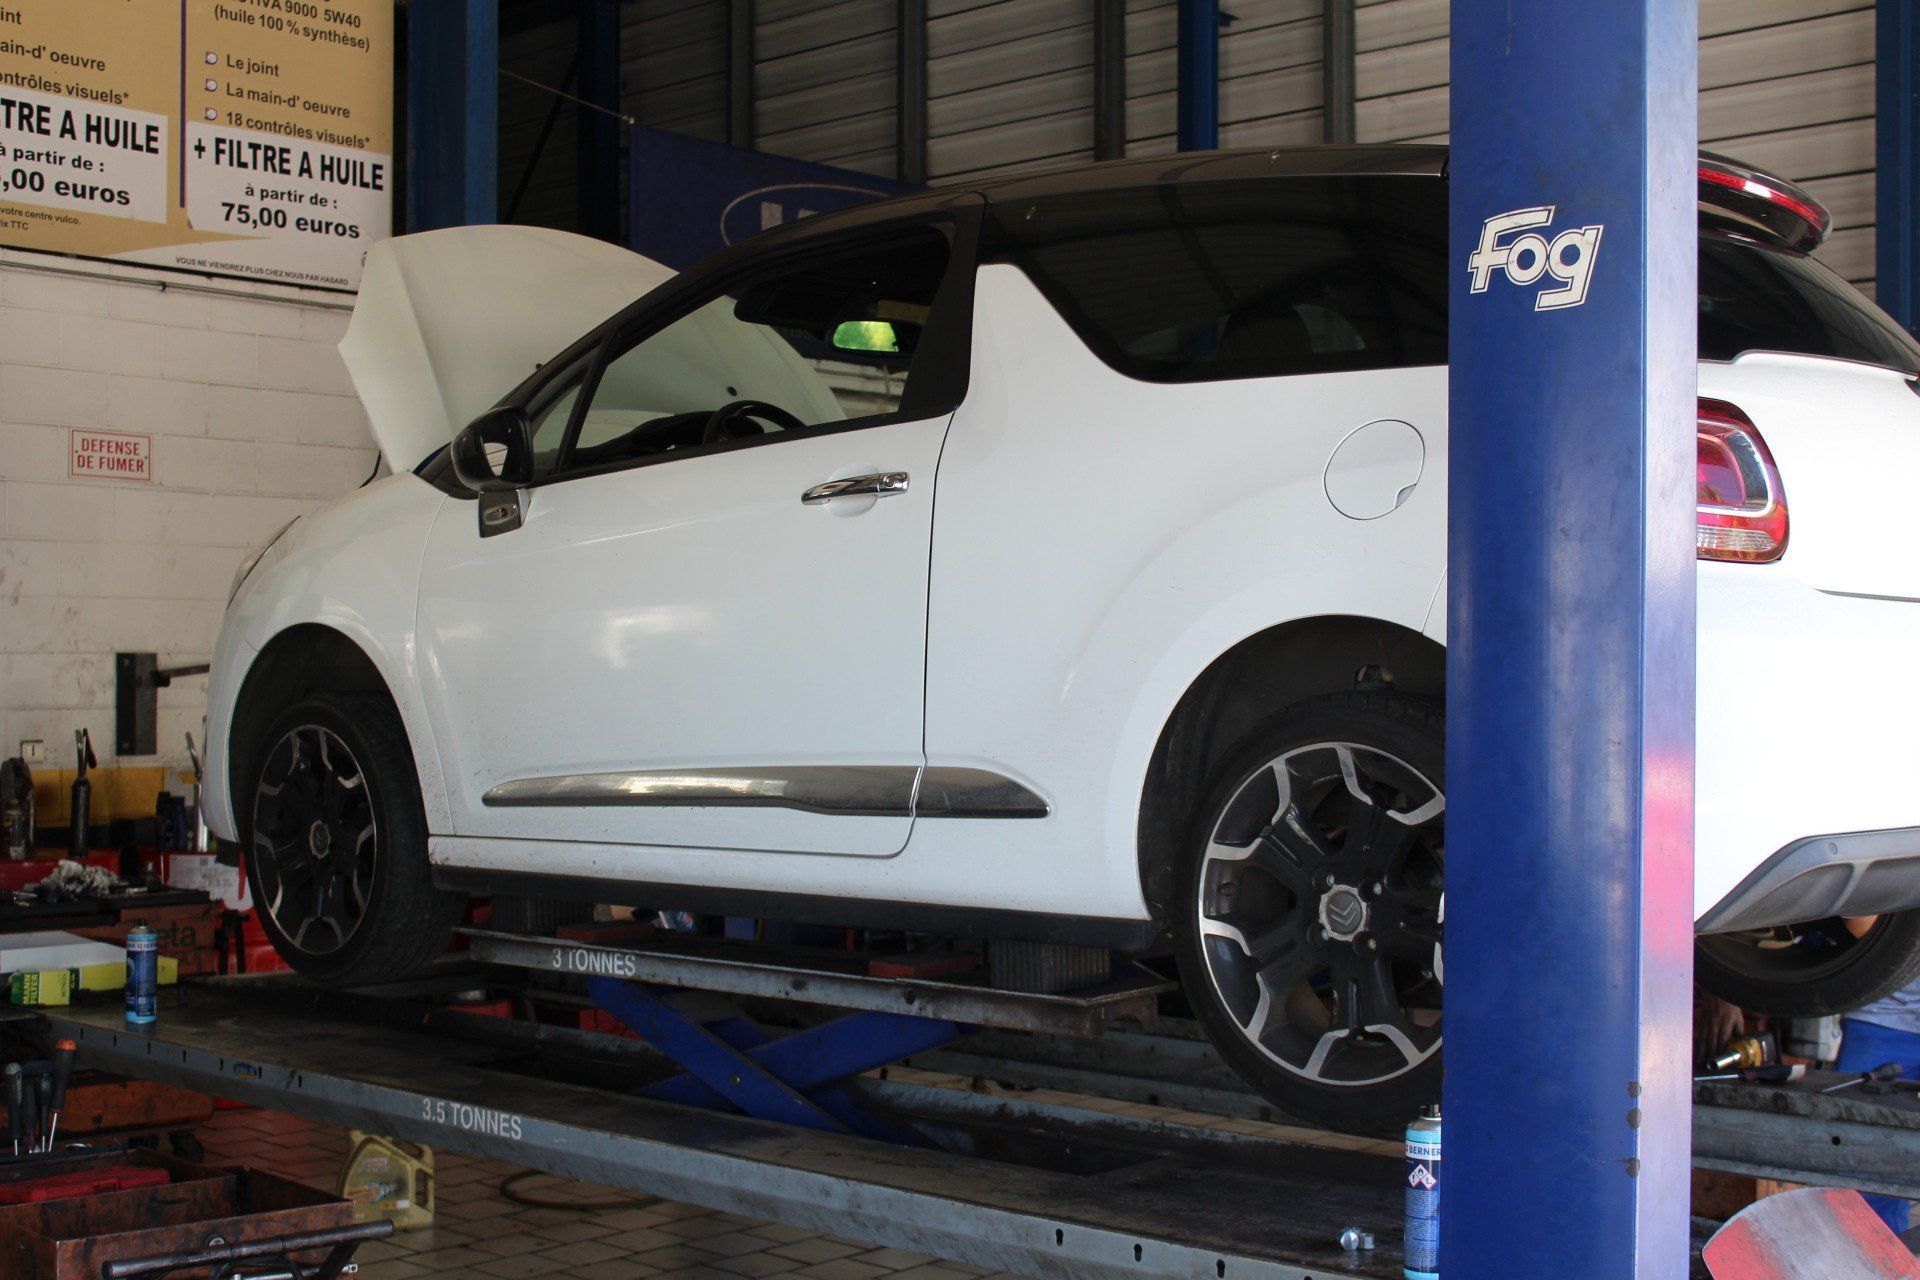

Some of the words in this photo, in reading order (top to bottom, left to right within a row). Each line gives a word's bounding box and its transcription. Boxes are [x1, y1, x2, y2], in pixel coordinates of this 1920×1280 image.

[214, 4, 255, 25] (huile
[259, 14, 283, 31] 100
[287, 20, 300, 35] %
[303, 26, 370, 53] synthèse)
[285, 1, 318, 19] 9000
[324, 9, 361, 28] 5W40
[50, 51, 106, 72] oeuvre
[226, 54, 244, 70] Le
[246, 58, 280, 77] joint
[226, 82, 244, 98] La
[247, 89, 300, 108] main-d'
[302, 100, 350, 118] oeuvre
[0, 97, 51, 136] TRE
[59, 110, 77, 140] A
[85, 113, 159, 155] HUILE
[226, 112, 243, 126] 18
[246, 118, 313, 140] contrôles
[13, 147, 66, 166] partir
[71, 155, 94, 171] de
[194, 138, 206, 159] +
[214, 137, 291, 175] FILTRE
[298, 151, 313, 179] A
[320, 154, 384, 191] HUILE
[0, 168, 45, 192] ,00
[54, 179, 131, 206] euros
[245, 184, 254, 197] à
[260, 187, 304, 204] partir
[309, 194, 328, 207] de
[0, 207, 23, 217] votre
[25, 210, 53, 221] centre
[0, 219, 9, 228] ix
[10, 220, 29, 231] TTC
[221, 202, 287, 229] 75,00
[295, 216, 360, 239] euros
[175, 256, 197, 266] VOUS
[208, 261, 245, 272] VIENDREZ
[245, 266, 264, 275] PLUS
[264, 268, 283, 277] CHEZ
[284, 271, 304, 280] NOUS
[305, 273, 320, 282] PAR
[320, 276, 349, 286] HASARD
[82, 438, 140, 455] DEFENSE
[77, 454, 94, 469] DE
[99, 456, 144, 473] FUMER
[552, 948, 562, 969] 3
[568, 949, 635, 976] TONNES
[22, 973, 31, 1005] MANN
[30, 973, 38, 1004] FILTER
[422, 1097, 446, 1124] 3.5
[450, 1102, 522, 1140] TONNES
